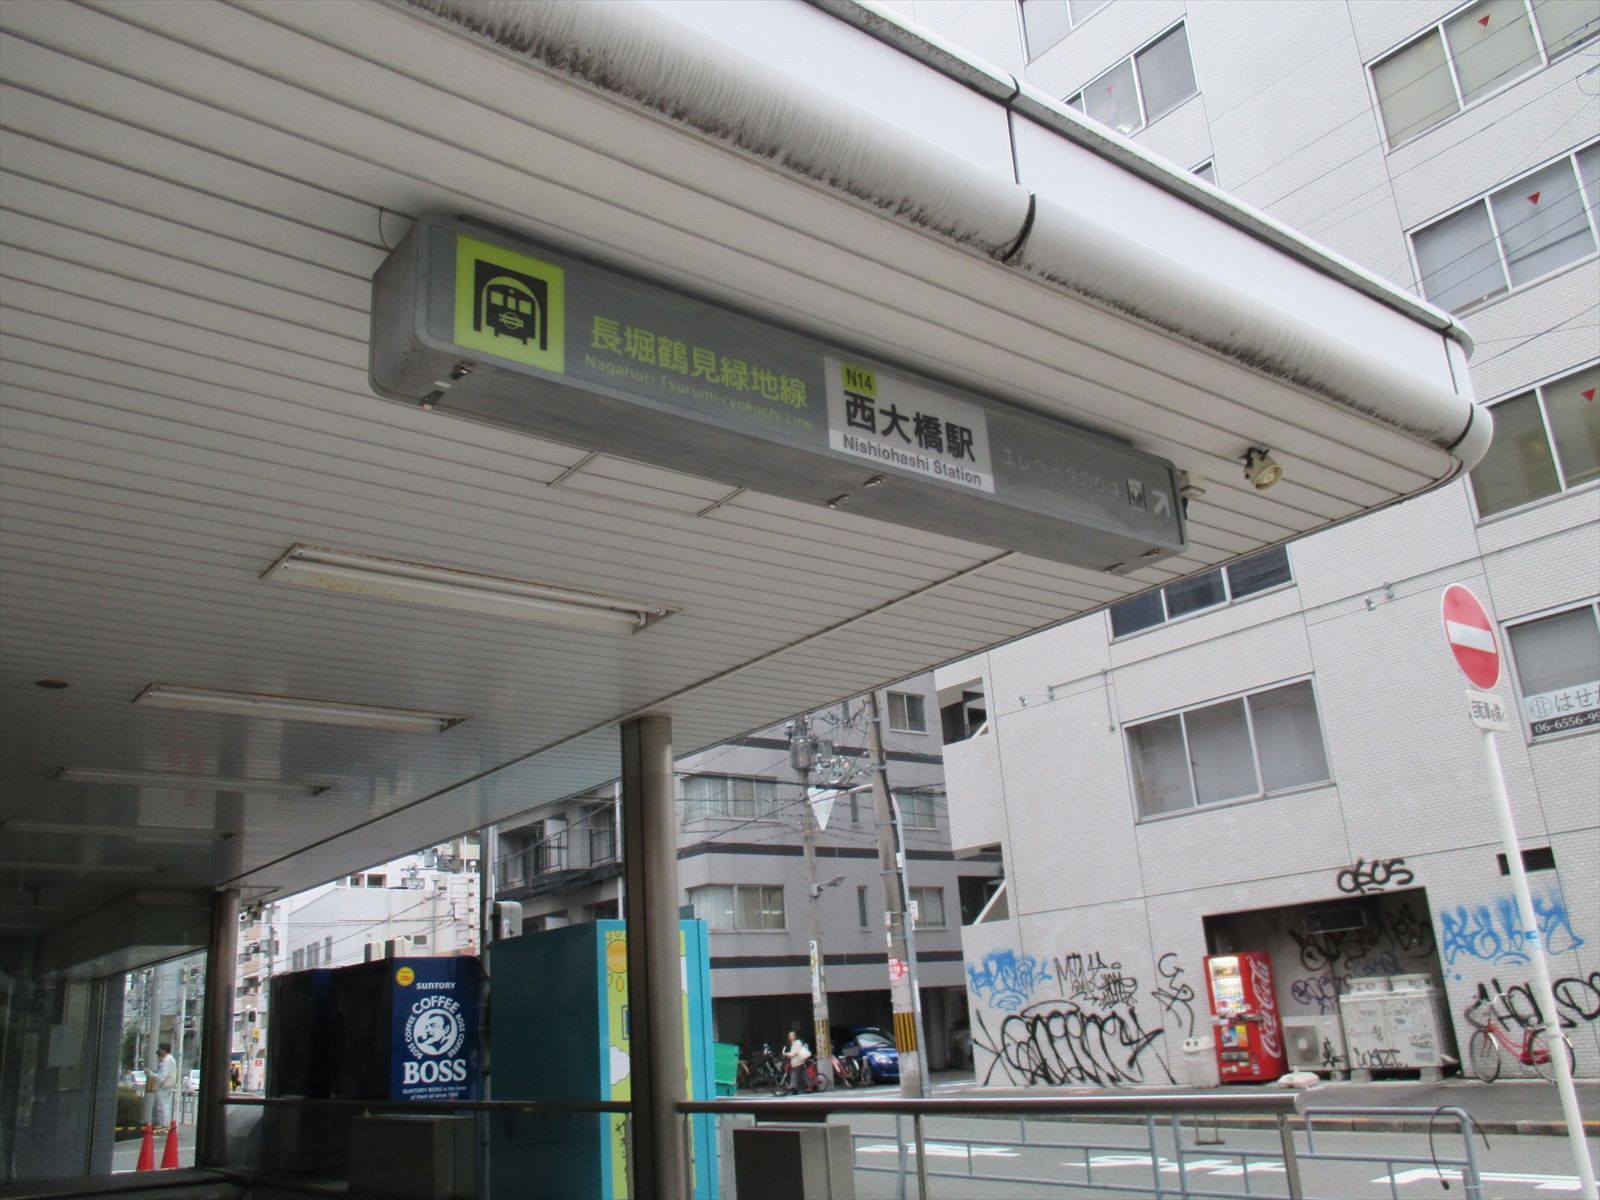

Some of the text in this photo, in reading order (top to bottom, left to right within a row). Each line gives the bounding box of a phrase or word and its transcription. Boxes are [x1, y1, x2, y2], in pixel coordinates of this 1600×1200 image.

[591, 315, 807, 408] 長堀鶴見緑地線
[846, 368, 872, 391] N14
[585, 352, 654, 384] Nagahori
[785, 414, 814, 430] Line
[844, 390, 975, 462] 西大橋駅
[843, 434, 982, 485] Nishiohashi Station
[412, 995, 460, 1014] COFFEE
[416, 981, 456, 990] SUNTORY
[1248, 954, 1281, 1058] Coca-Cola
[403, 1059, 466, 1085] BOSS
